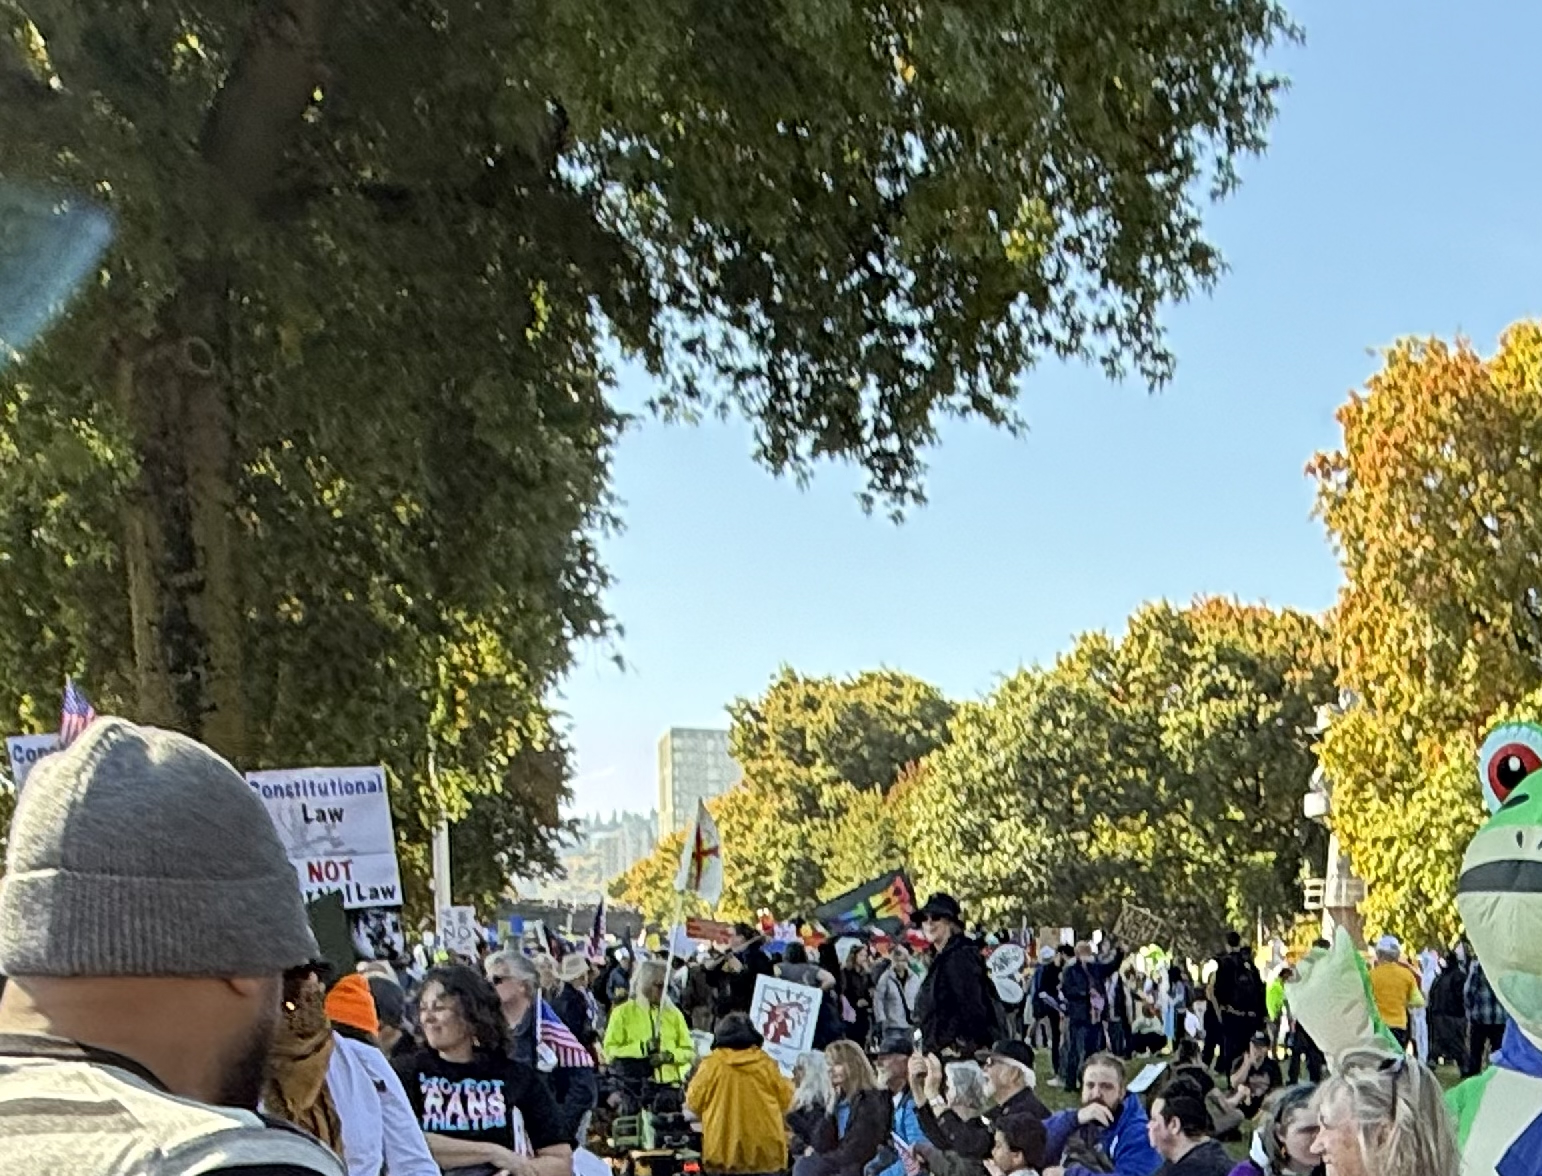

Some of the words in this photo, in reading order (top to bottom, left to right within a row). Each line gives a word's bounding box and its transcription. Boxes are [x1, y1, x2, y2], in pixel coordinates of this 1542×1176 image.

[302, 803, 345, 824] Law
[307, 859, 354, 883] NOT
[355, 882, 397, 902] Law
[422, 1087, 507, 1119] RANS
